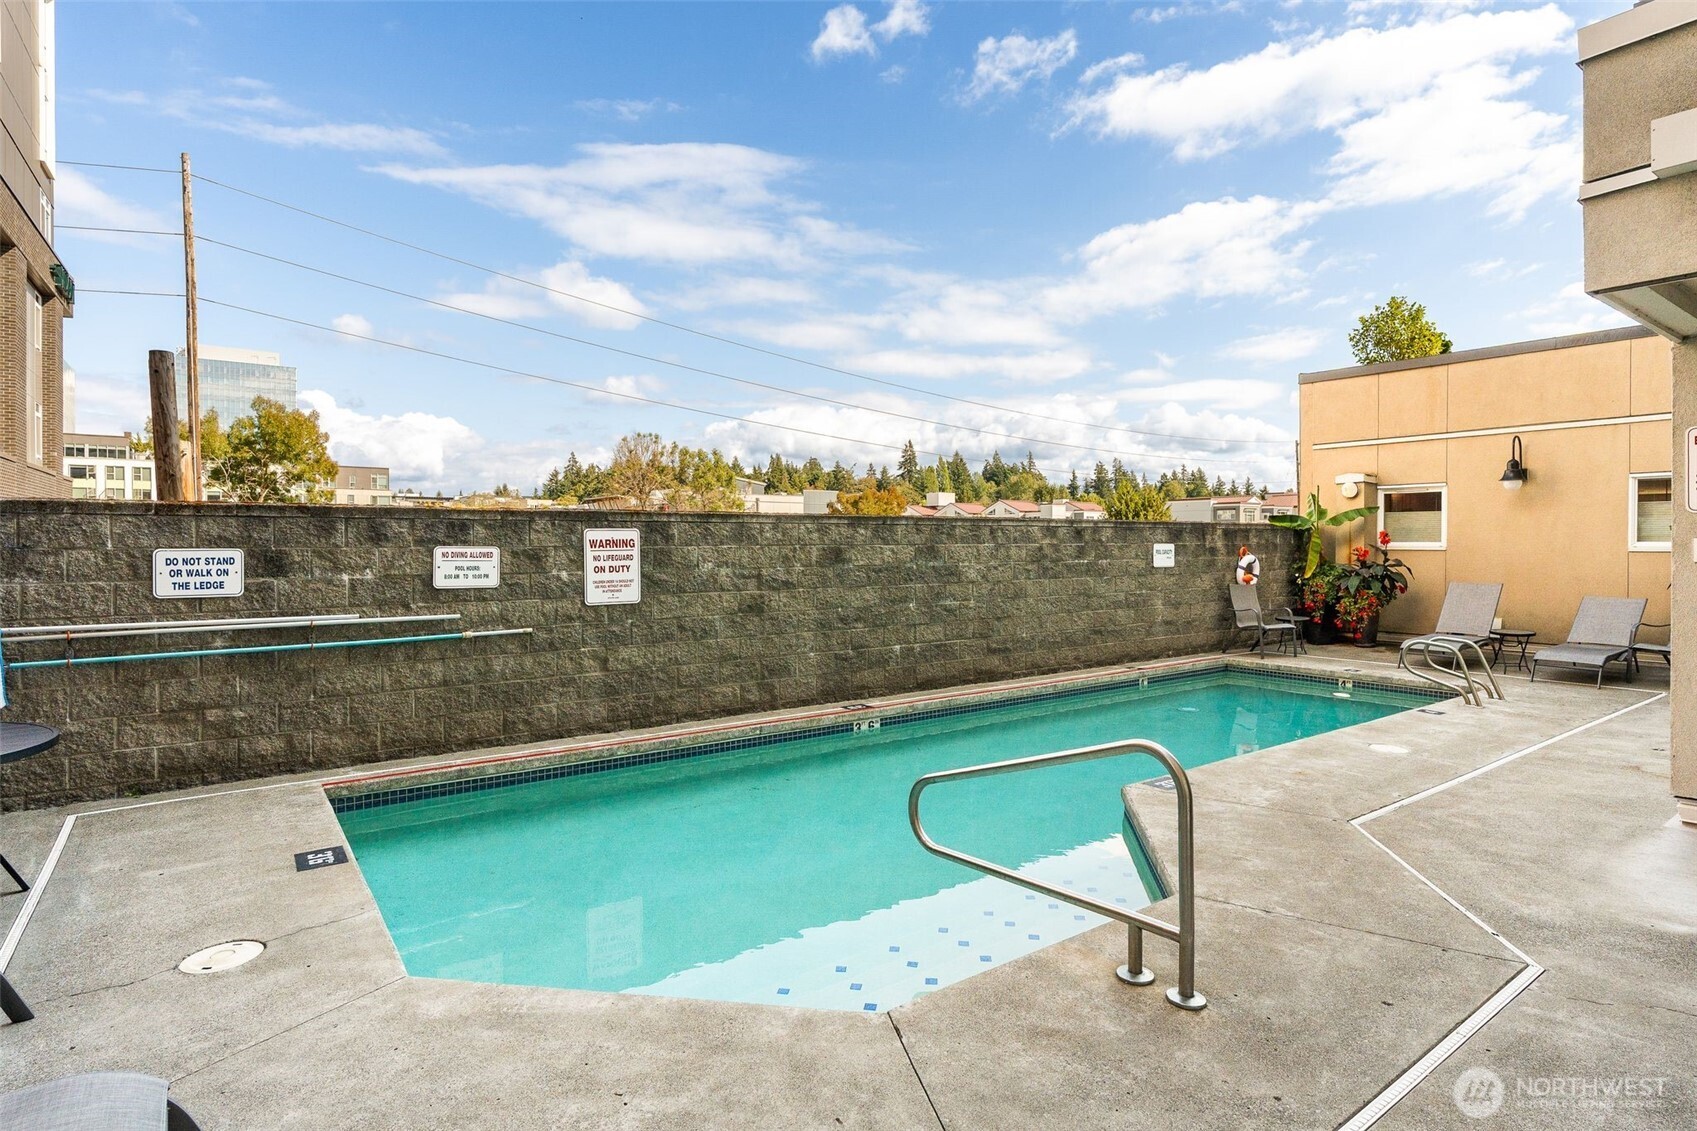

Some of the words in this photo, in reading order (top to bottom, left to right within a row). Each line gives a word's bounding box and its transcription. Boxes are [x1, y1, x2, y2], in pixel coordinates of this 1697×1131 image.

[588, 538, 636, 548] WARNING
[165, 558, 178, 566] DO
[182, 558, 202, 566] NOT
[204, 557, 236, 566] STAND
[169, 569, 182, 578] OR
[186, 569, 212, 578] WALK
[216, 568, 229, 576] ON
[594, 566, 606, 574] ON
[608, 564, 630, 572] DUTY
[172, 582, 190, 590] THE
[194, 581, 224, 590] LEDGE
[868, 720, 874, 728] 6
